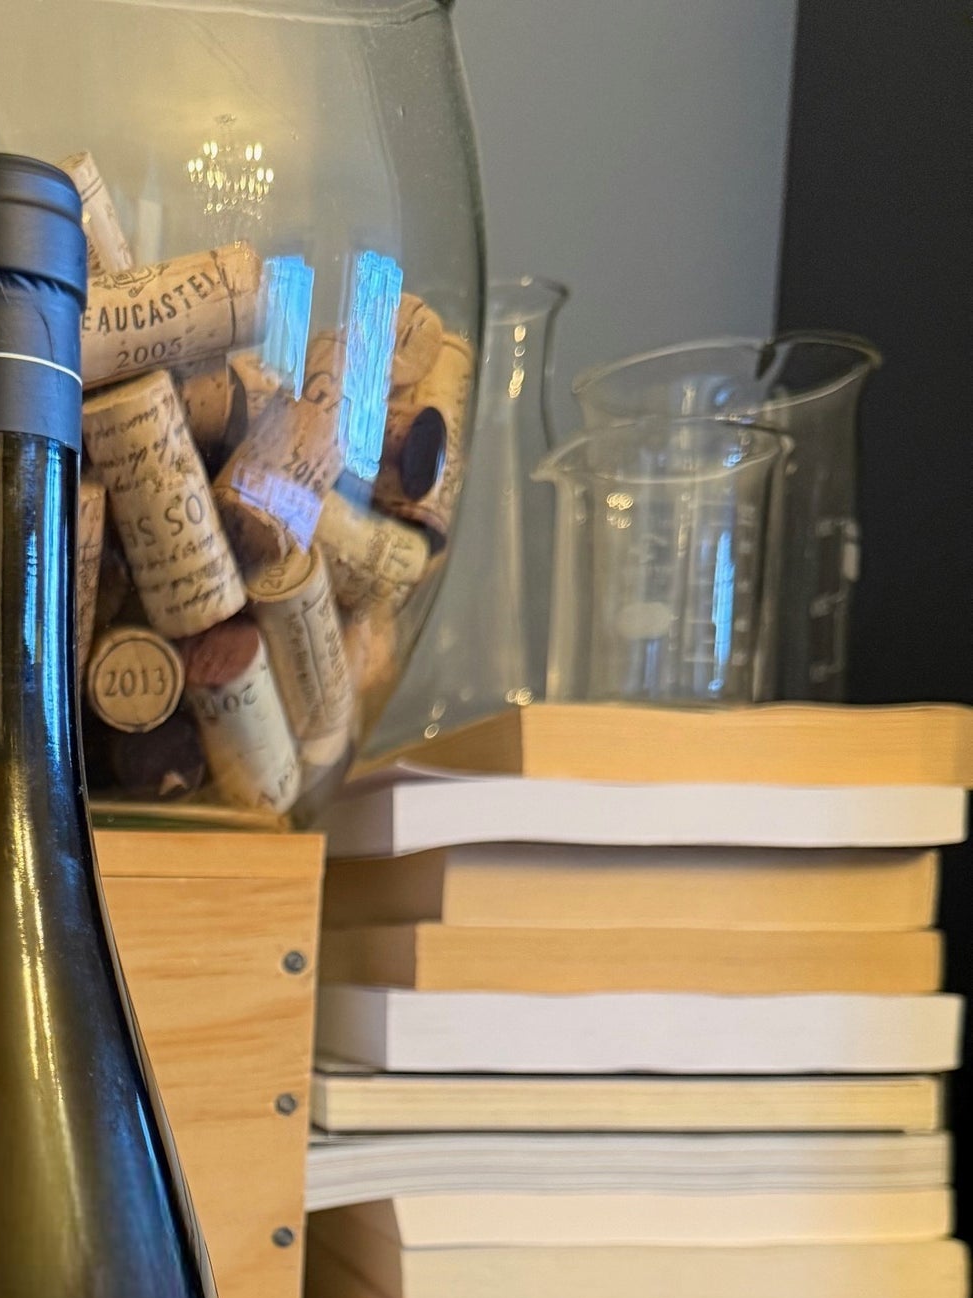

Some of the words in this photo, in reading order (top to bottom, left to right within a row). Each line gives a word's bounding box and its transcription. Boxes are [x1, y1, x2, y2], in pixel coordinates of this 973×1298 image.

[81, 272, 221, 335] EAUCASTEL
[115, 336, 183, 371] 2005
[104, 666, 168, 698] 2013
